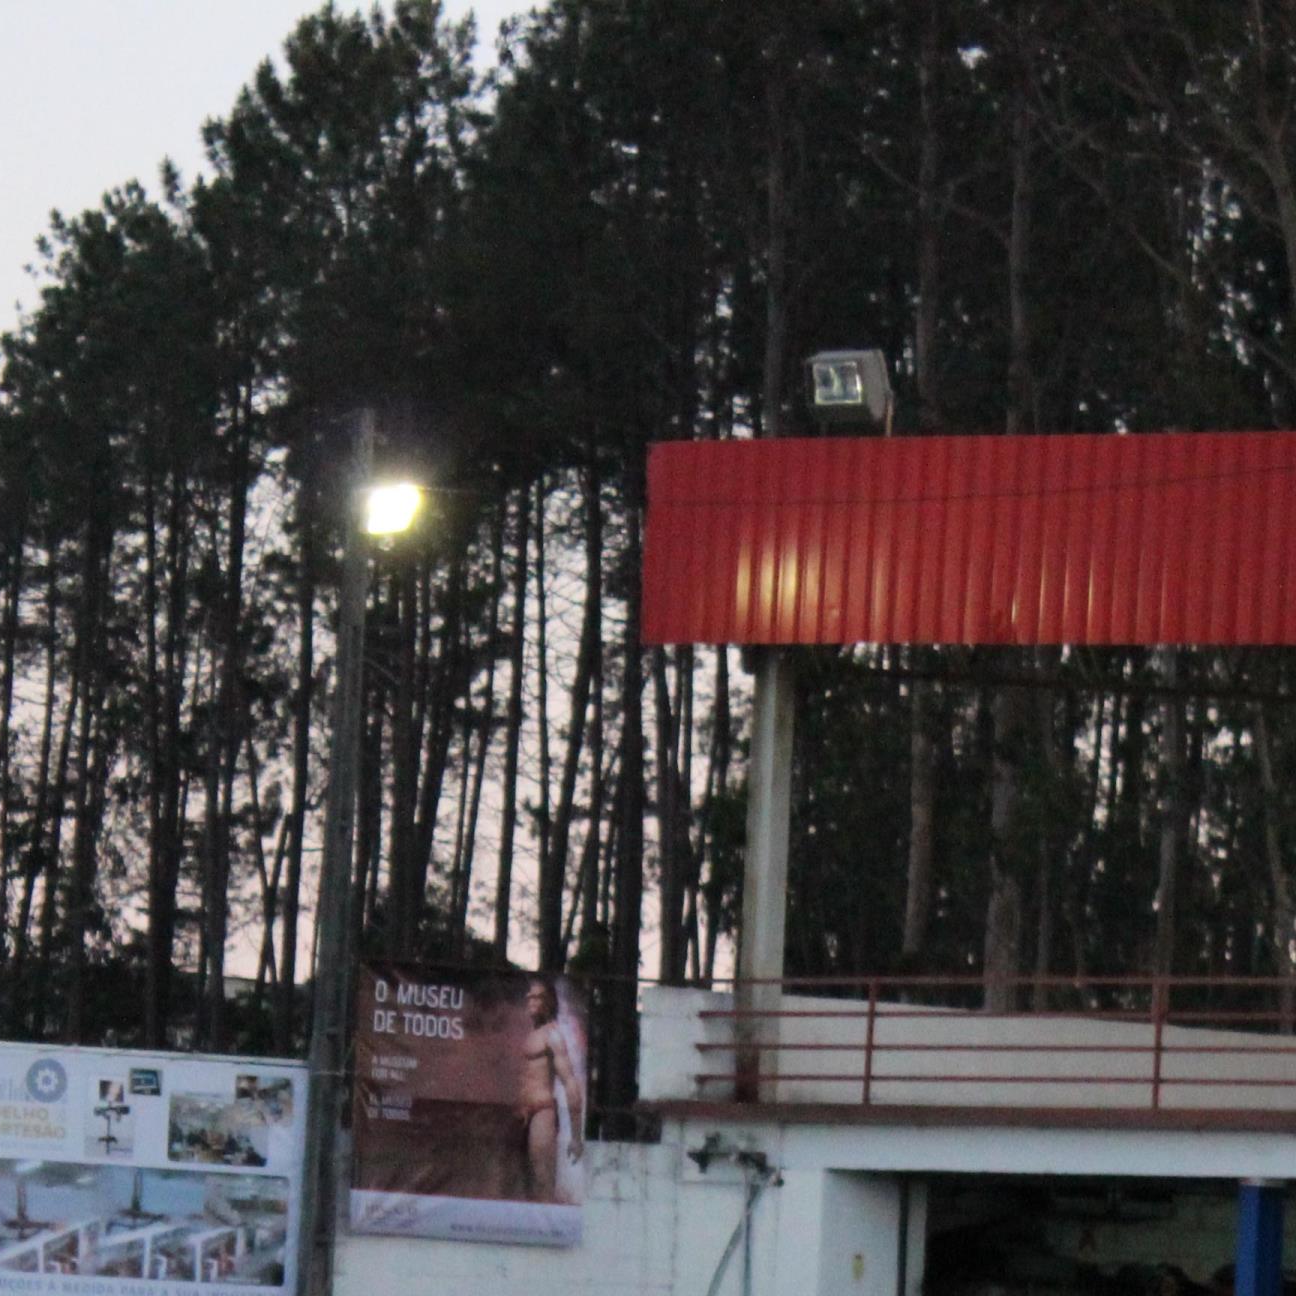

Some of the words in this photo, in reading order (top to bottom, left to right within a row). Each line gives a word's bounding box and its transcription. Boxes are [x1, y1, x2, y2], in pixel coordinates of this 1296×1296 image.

[375, 980, 388, 1002] O
[397, 984, 463, 1009] MUSEU
[374, 1010, 396, 1033] DE
[404, 1013, 464, 1039] TODOS
